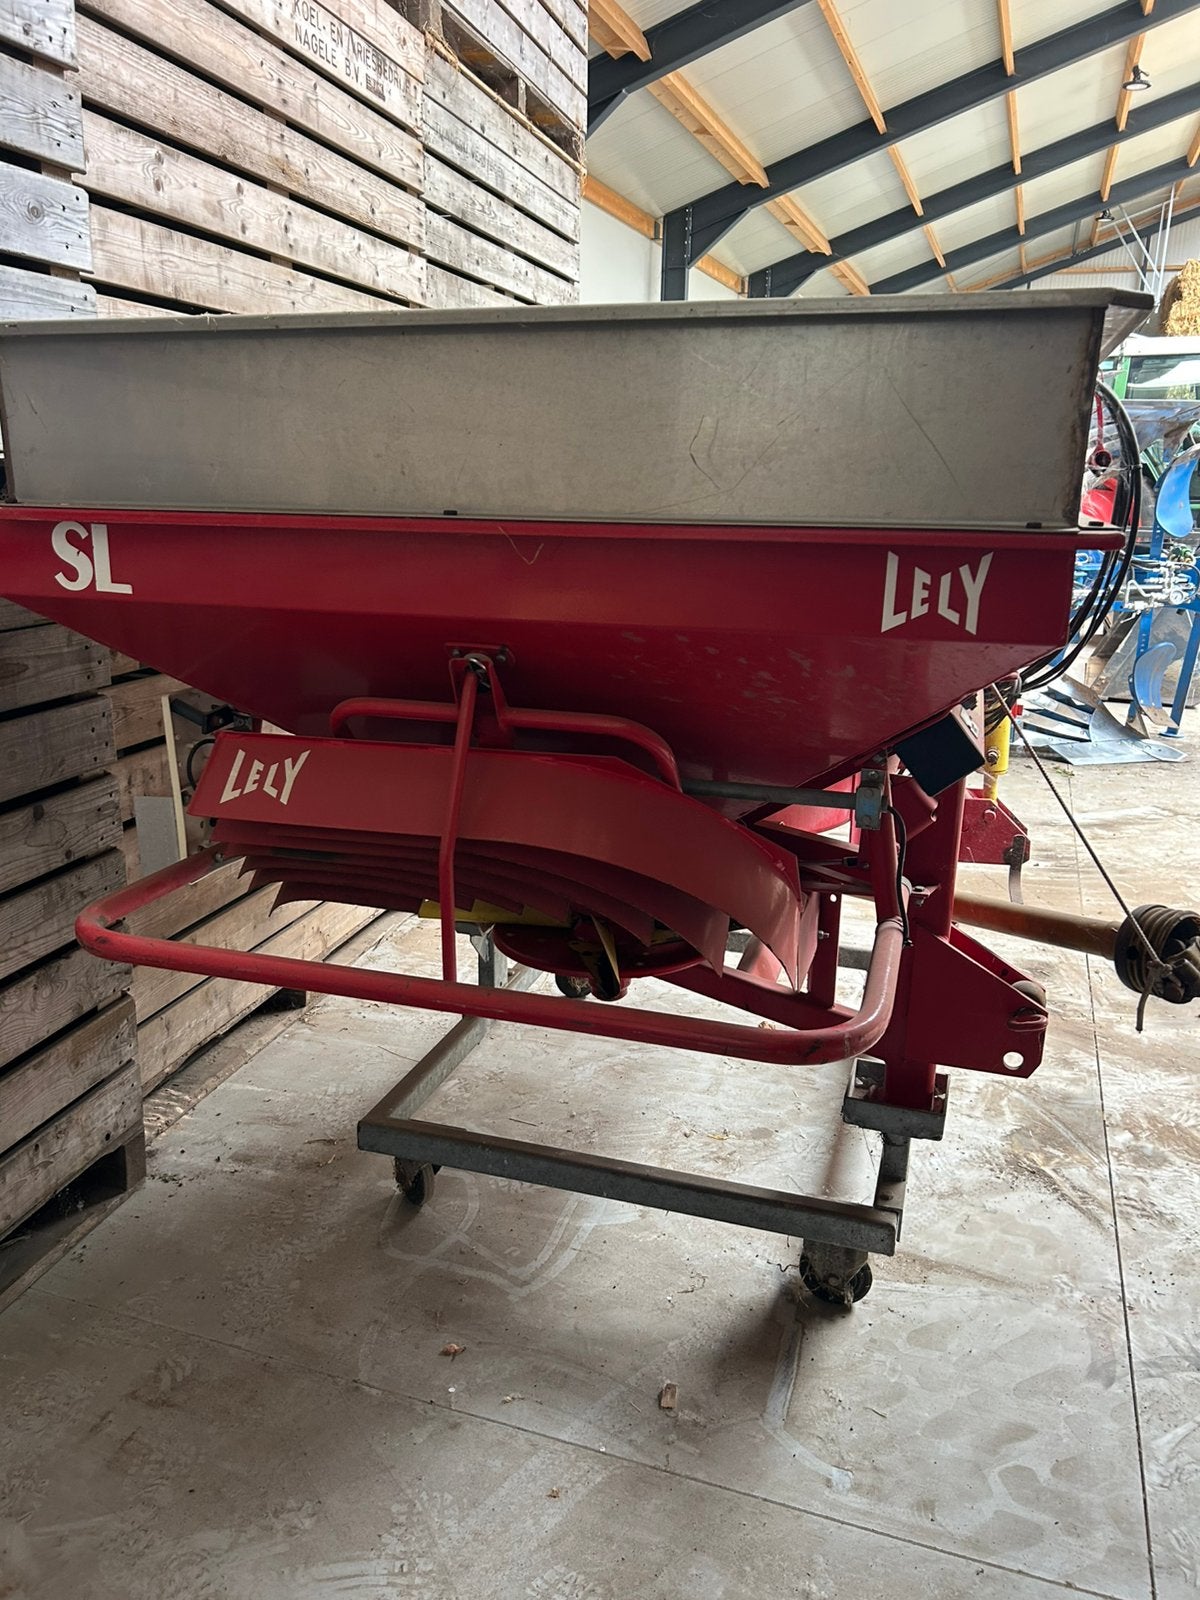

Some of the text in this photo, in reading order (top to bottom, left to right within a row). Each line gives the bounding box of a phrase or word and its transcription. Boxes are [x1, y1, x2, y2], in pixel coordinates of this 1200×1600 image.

[295, 23, 338, 69] NAGELE
[330, 21, 343, 48] EN
[51, 521, 133, 595] SL
[881, 550, 994, 636] LELY
[219, 749, 311, 806] LELY
